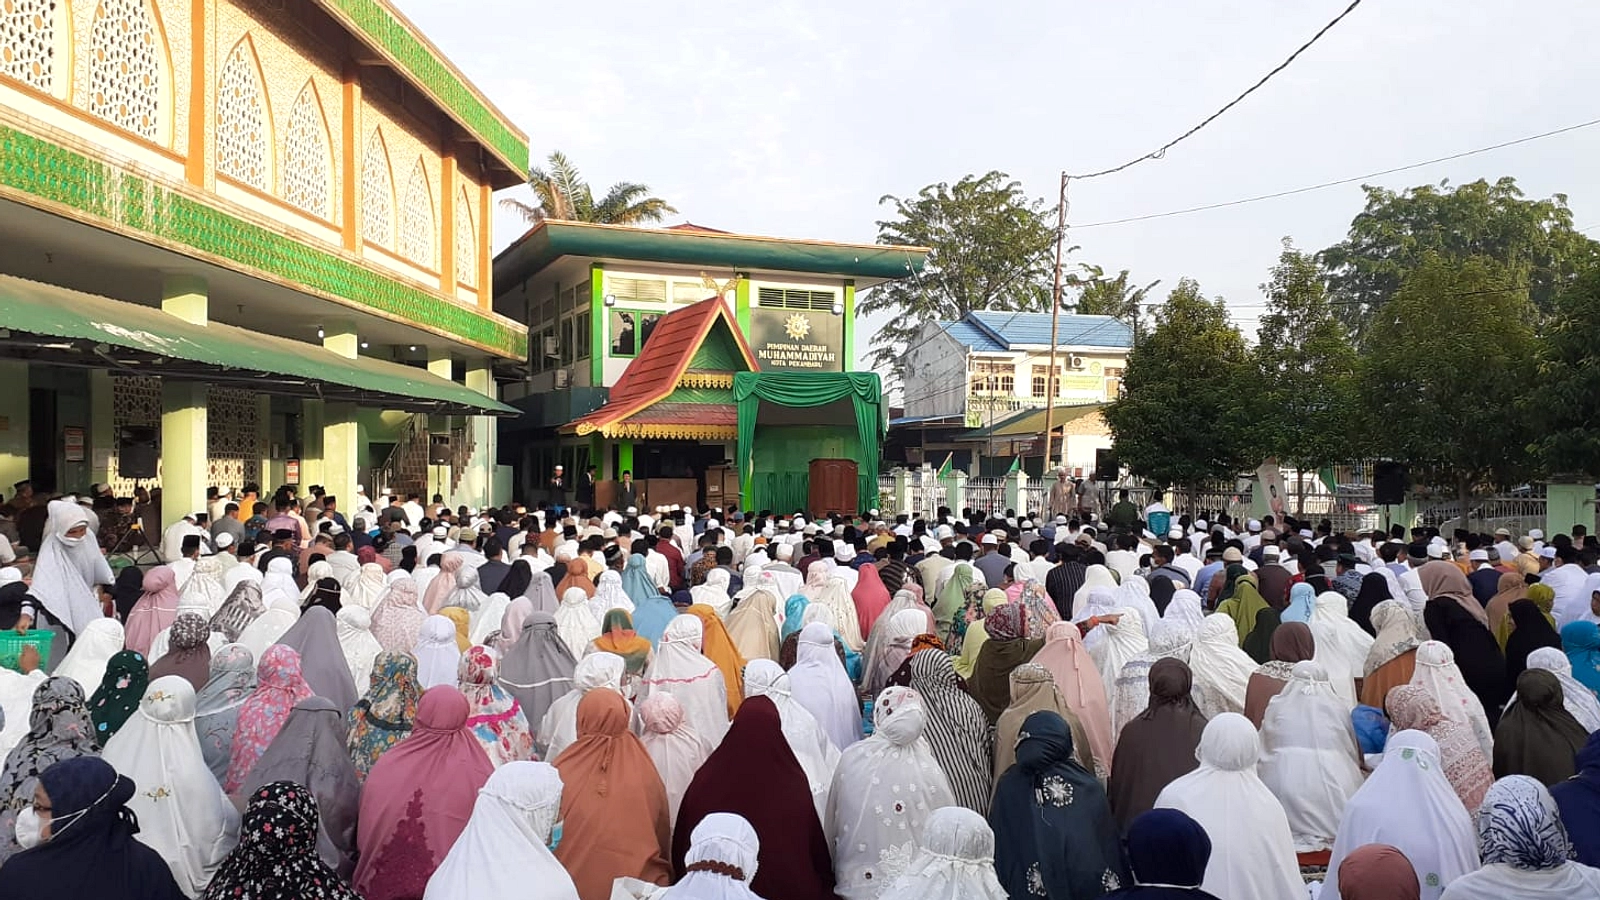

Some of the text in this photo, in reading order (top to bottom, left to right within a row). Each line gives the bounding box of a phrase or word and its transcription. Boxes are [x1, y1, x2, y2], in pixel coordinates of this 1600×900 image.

[801, 344, 827, 352] DAERAH
[758, 350, 835, 361] MUHAMMADIYAH
[771, 359, 787, 367] KOTA
